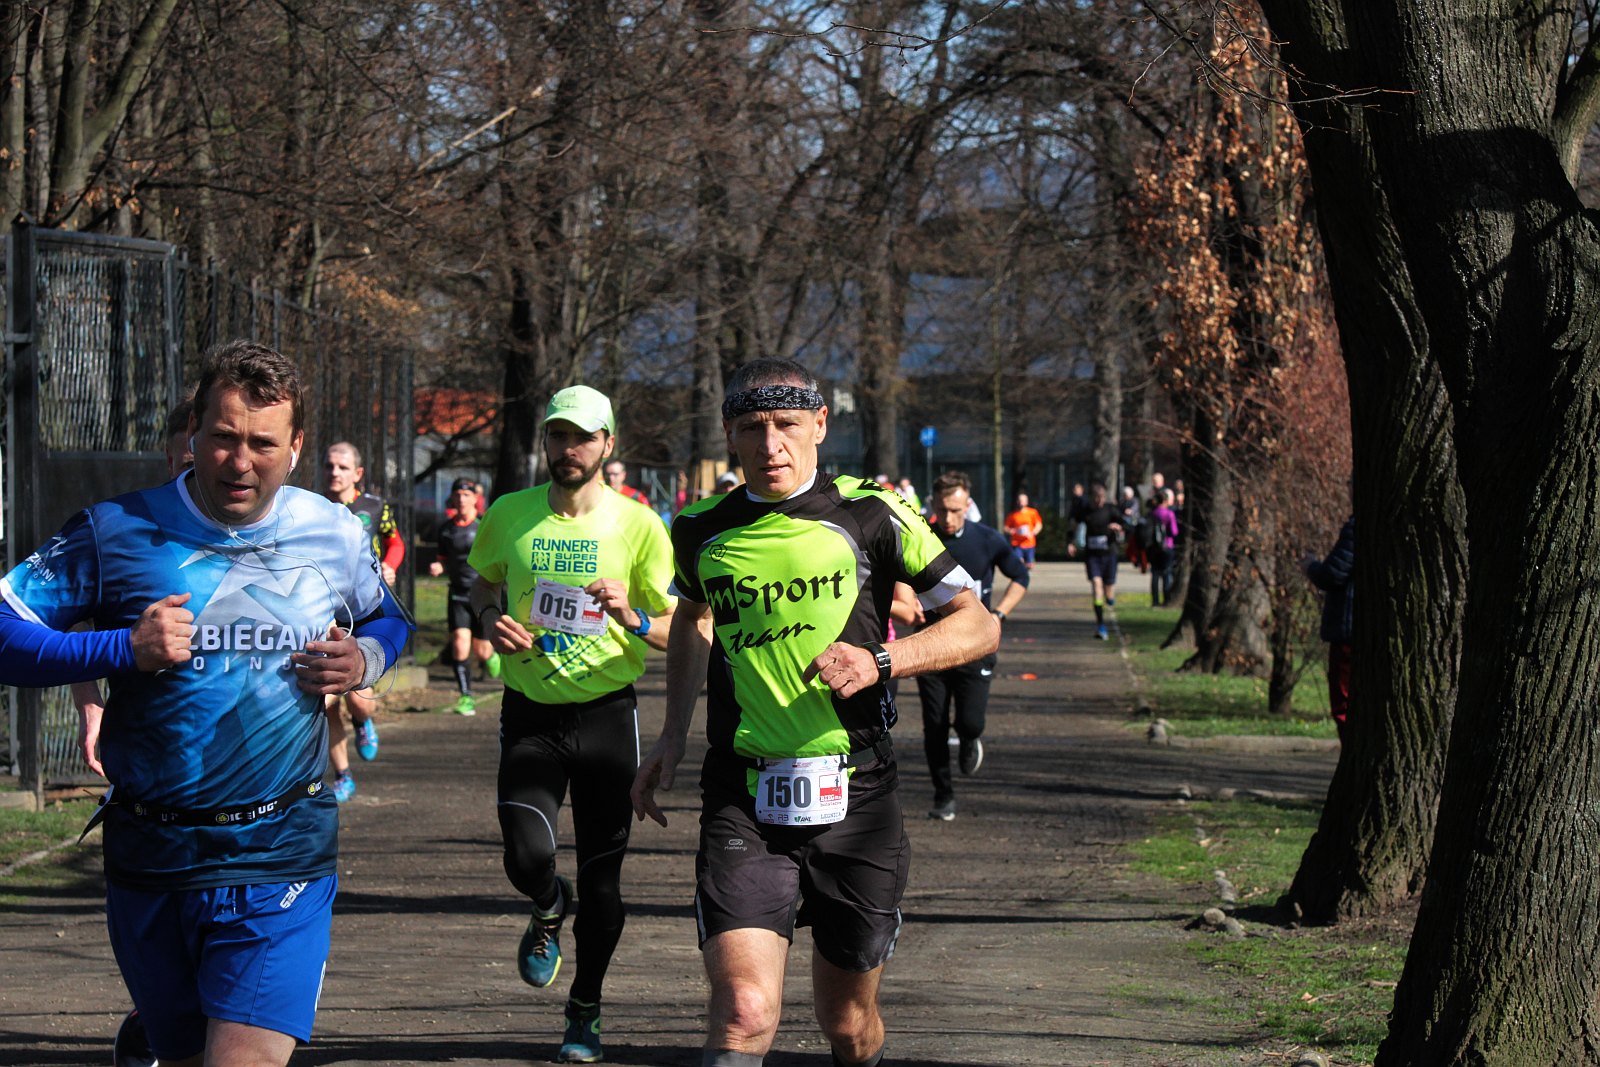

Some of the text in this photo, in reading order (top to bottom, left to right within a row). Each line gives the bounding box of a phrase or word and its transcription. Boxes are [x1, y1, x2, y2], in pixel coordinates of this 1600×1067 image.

[555, 561, 597, 573] BIEG
[540, 592, 577, 621] 015
[730, 622, 816, 654] team
[765, 776, 811, 808] 150
